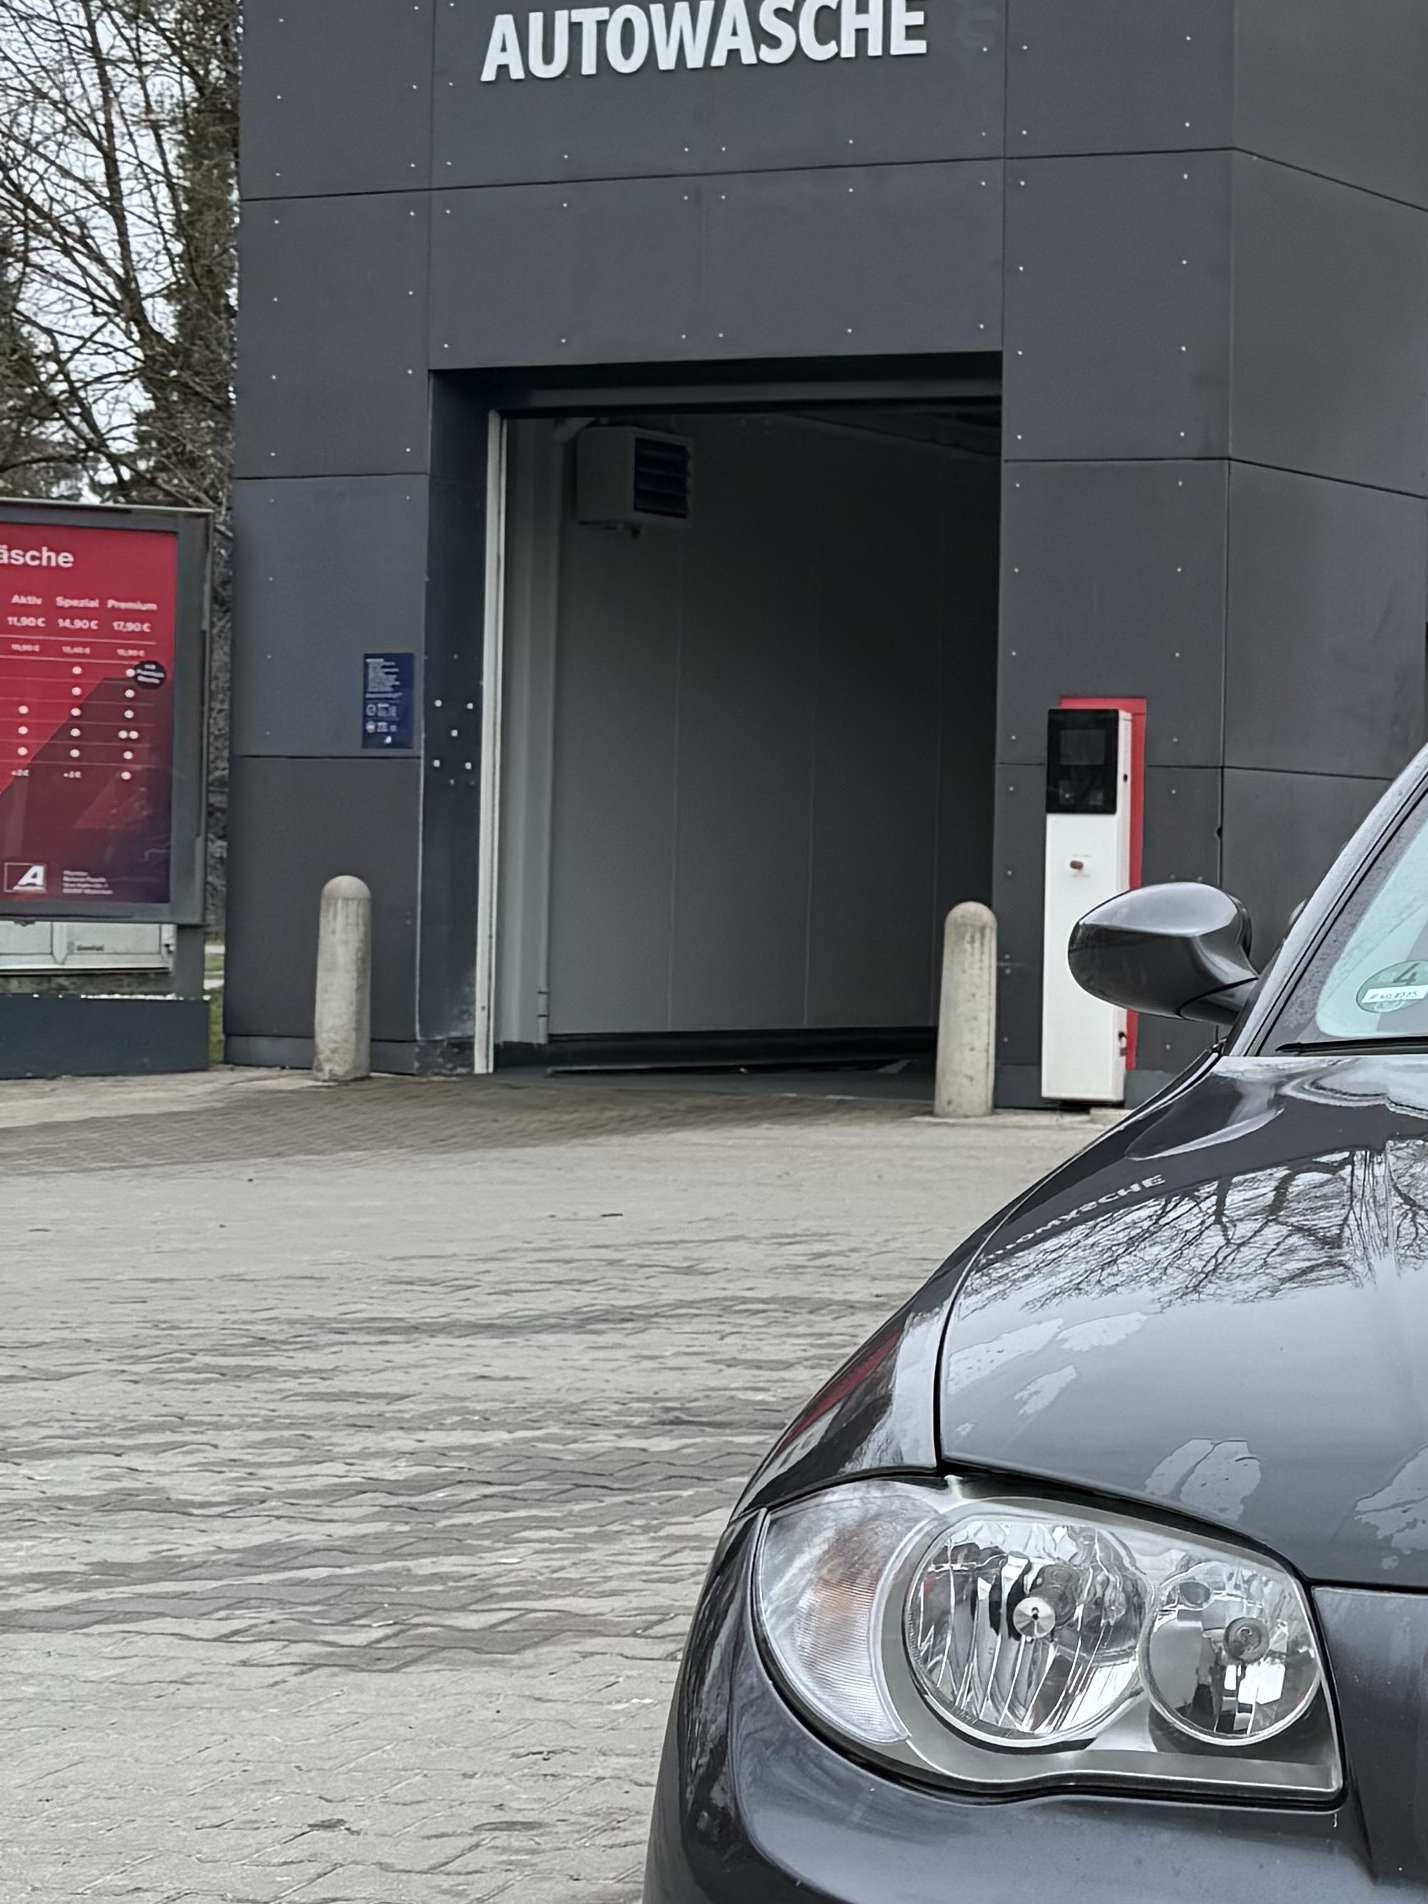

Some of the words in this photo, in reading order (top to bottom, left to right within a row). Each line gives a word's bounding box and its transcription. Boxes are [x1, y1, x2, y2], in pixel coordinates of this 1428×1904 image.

[55, 596, 99, 608] Spezial
[107, 599, 158, 611] Premium
[1392, 962, 1420, 984] 4
